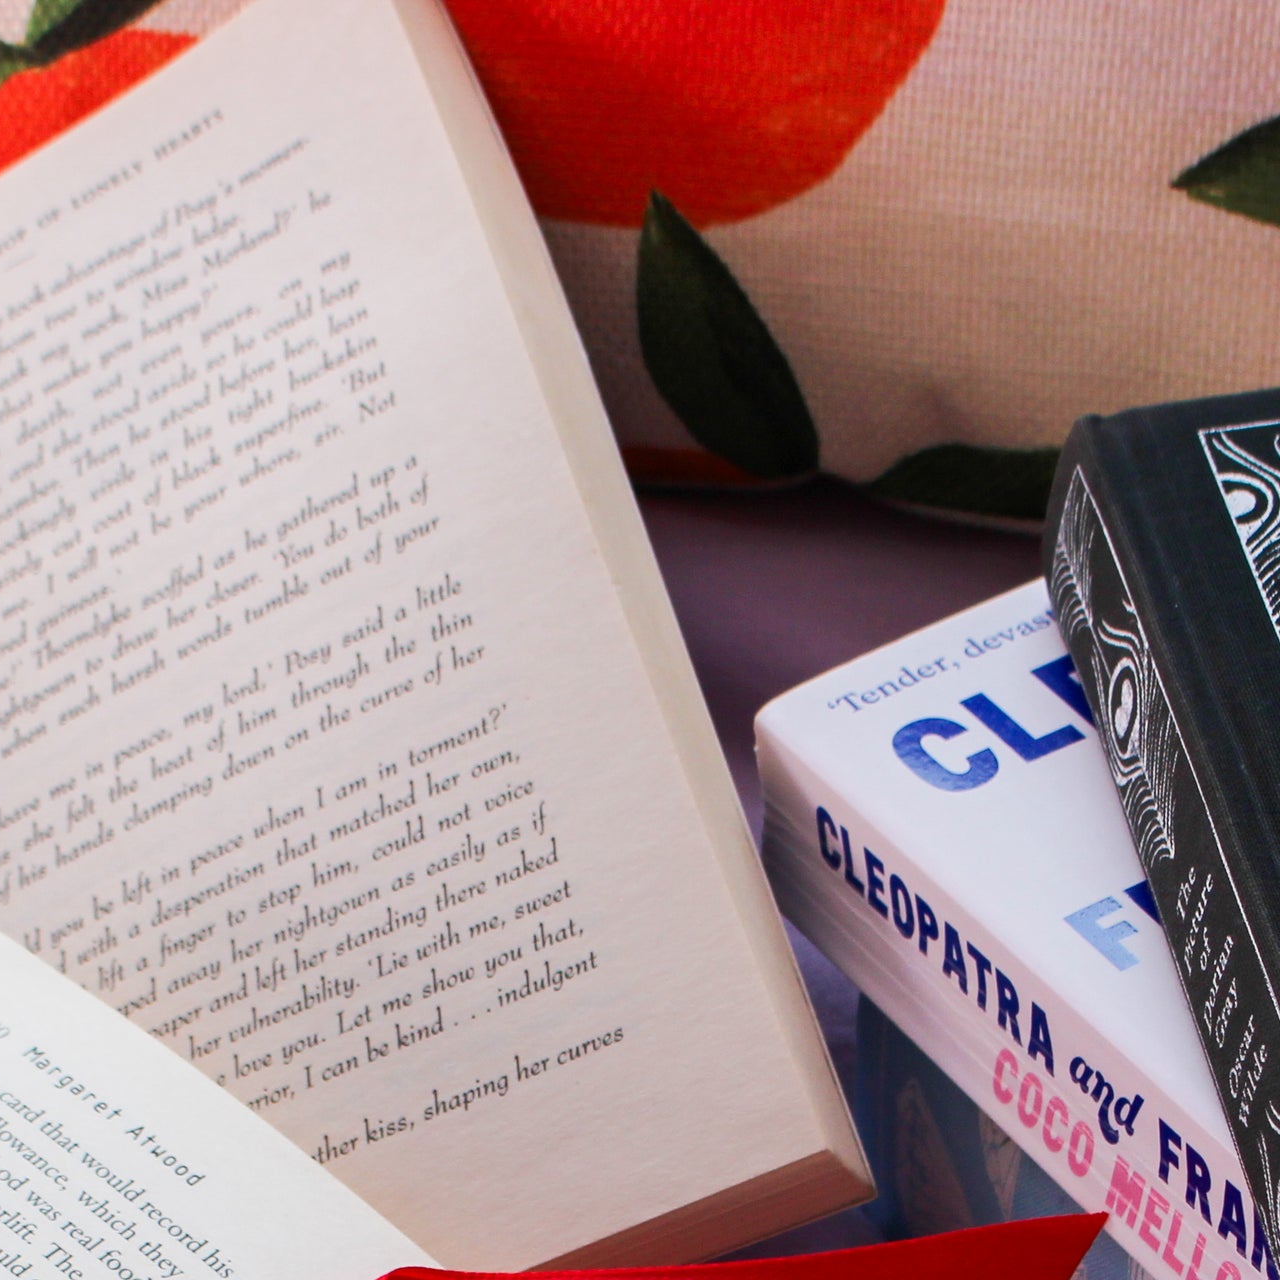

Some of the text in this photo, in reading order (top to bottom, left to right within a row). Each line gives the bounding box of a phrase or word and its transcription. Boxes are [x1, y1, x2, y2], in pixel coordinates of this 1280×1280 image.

[1176, 866, 1197, 921] The
[186, 1033, 222, 1070] her
[227, 974, 360, 1043] vulnerability.
[415, 919, 461, 961] with
[467, 914, 506, 939] me,
[513, 879, 571, 920] sweet
[231, 917, 584, 1080] love you. Let me show you that,
[816, 805, 1056, 1079] CLEOPATRA
[1069, 1055, 1145, 1145] and
[1203, 935, 1234, 1036] Dorian
[1215, 977, 1238, 1049] Gray
[21, 1044, 123, 1120] Margaret
[123, 1125, 207, 1187] Atwood
[362, 1026, 624, 1145] kiss, shaping her curves
[993, 1047, 1095, 1178] COCO
[38, 1120, 80, 1154] that
[80, 1151, 147, 1203] would
[137, 1200, 209, 1254] record
[200, 1247, 234, 1279] his
